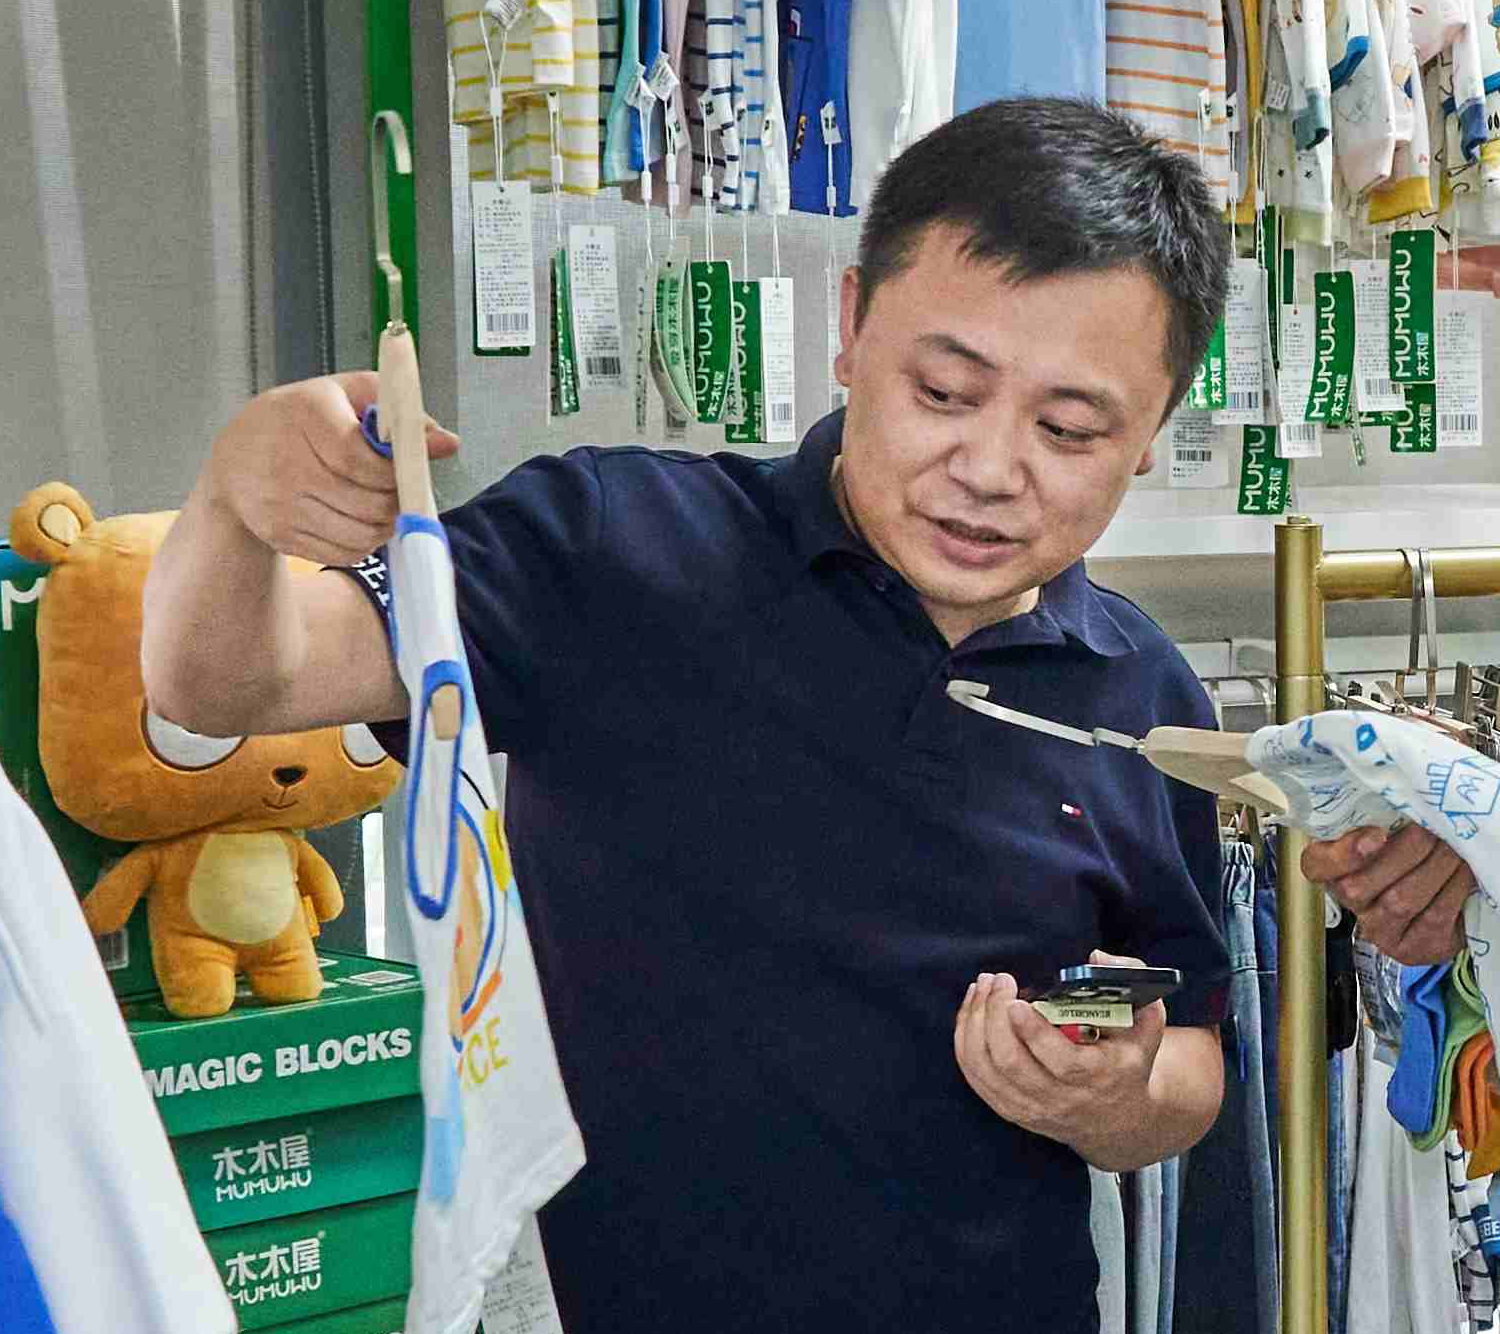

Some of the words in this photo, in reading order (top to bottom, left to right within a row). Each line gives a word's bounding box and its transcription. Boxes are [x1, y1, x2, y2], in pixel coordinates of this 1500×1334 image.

[1395, 249, 1412, 378] MUMUWU
[1309, 292, 1336, 417] MUMUWU
[142, 1052, 263, 1098] MAGIC
[275, 1028, 412, 1078] BLOCKS
[212, 1134, 311, 1181] 木木屋
[215, 1169, 312, 1202] MUMUWU
[225, 1237, 321, 1287] 木木屋
